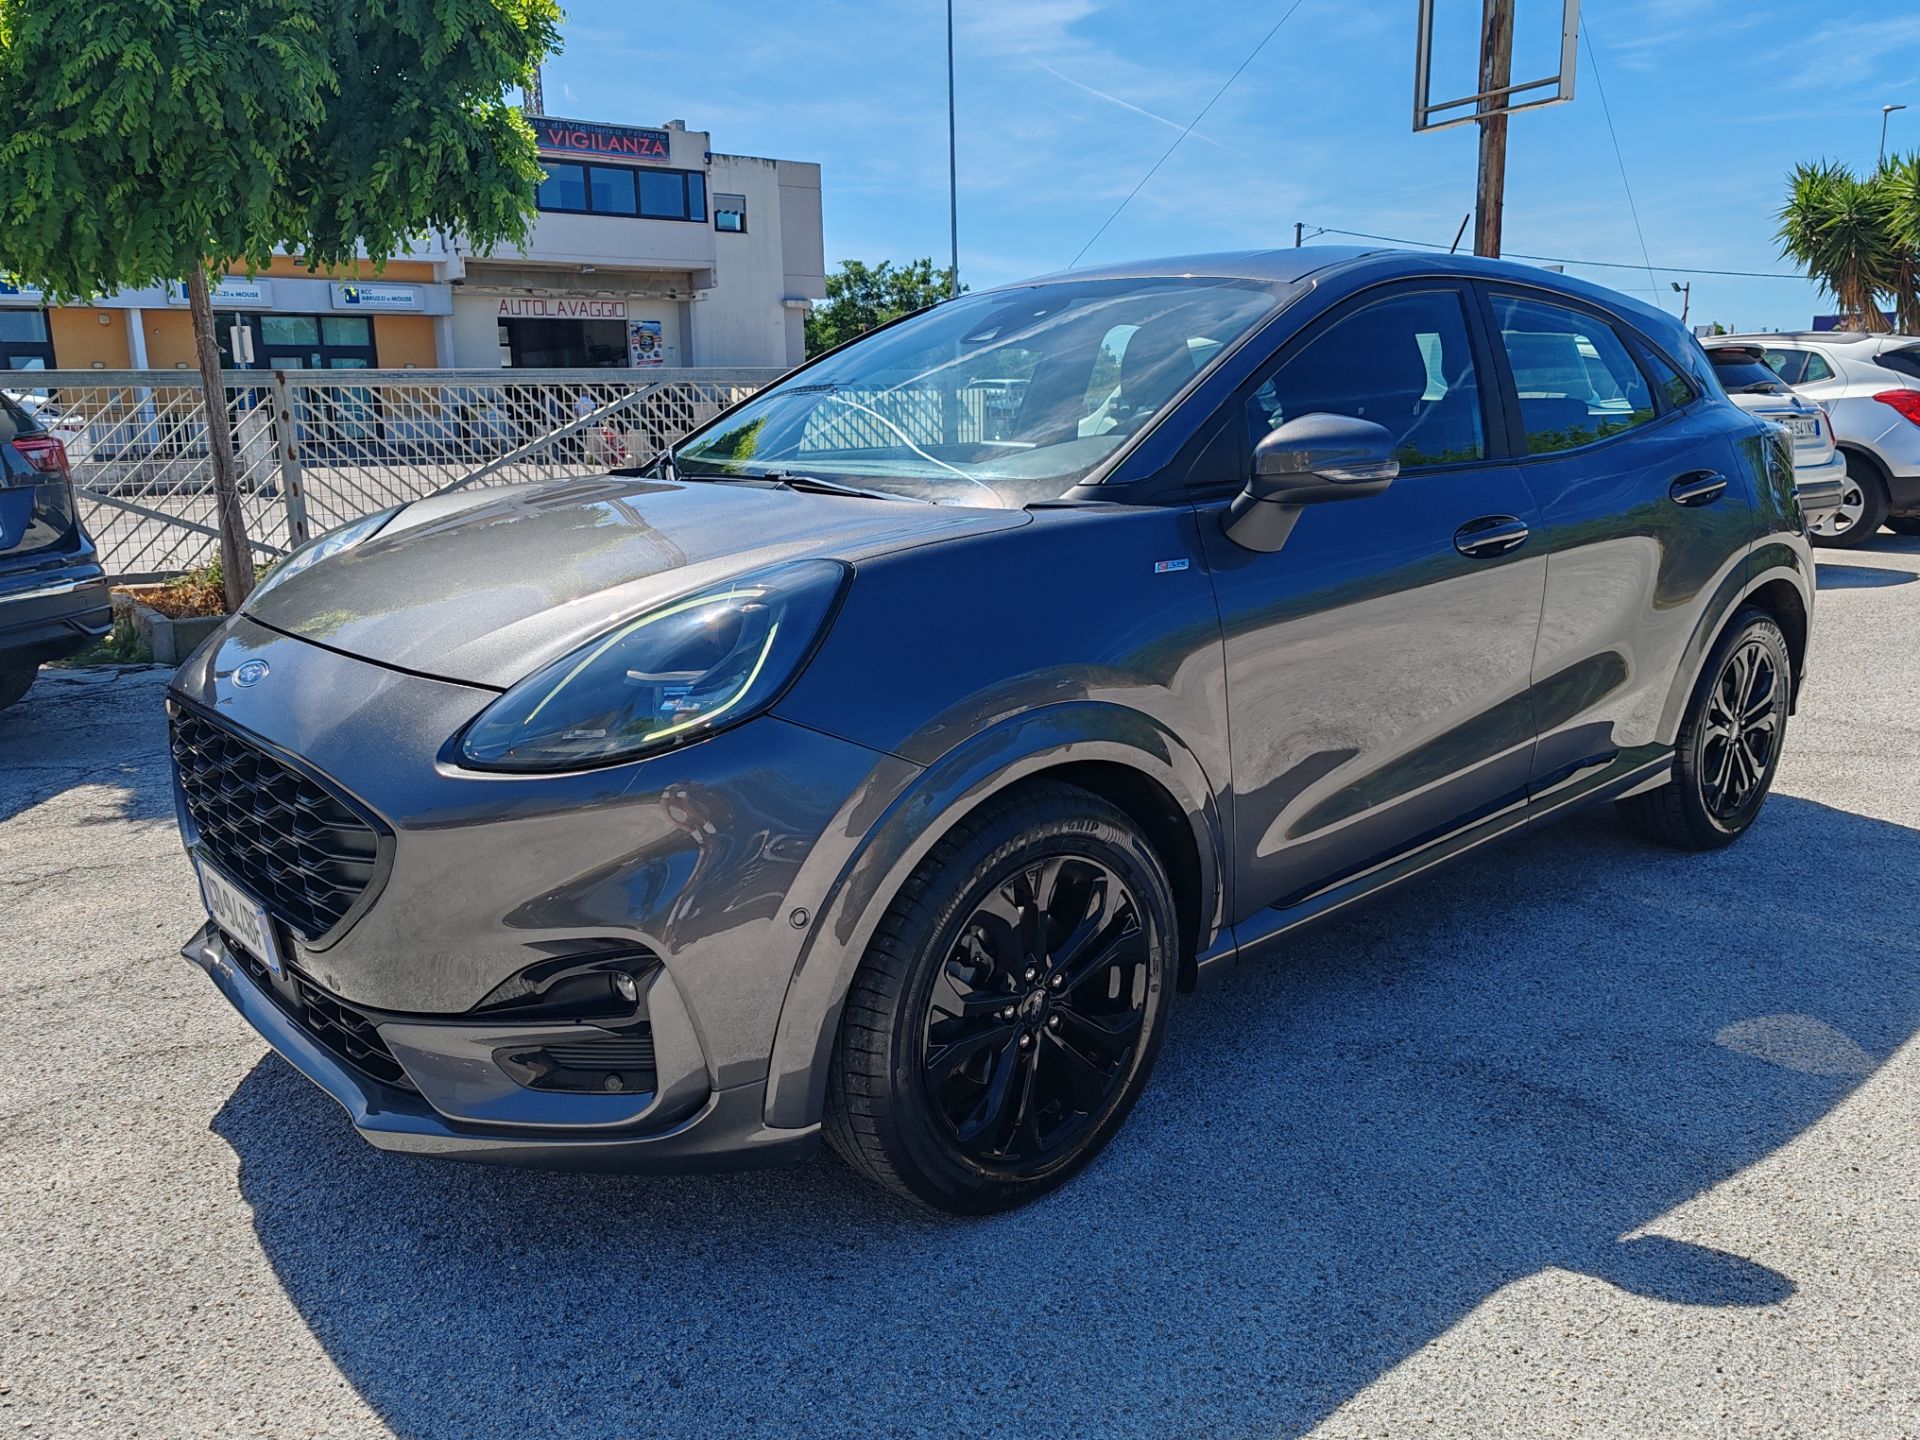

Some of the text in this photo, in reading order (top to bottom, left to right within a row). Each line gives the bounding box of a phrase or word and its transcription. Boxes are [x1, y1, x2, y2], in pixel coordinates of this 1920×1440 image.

[551, 121, 562, 129] di
[567, 122, 622, 136] Vigilanza
[627, 129, 666, 140] Privato
[548, 129, 666, 156] VIGILANZA
[499, 299, 625, 317] AUTOLAVAGGIO
